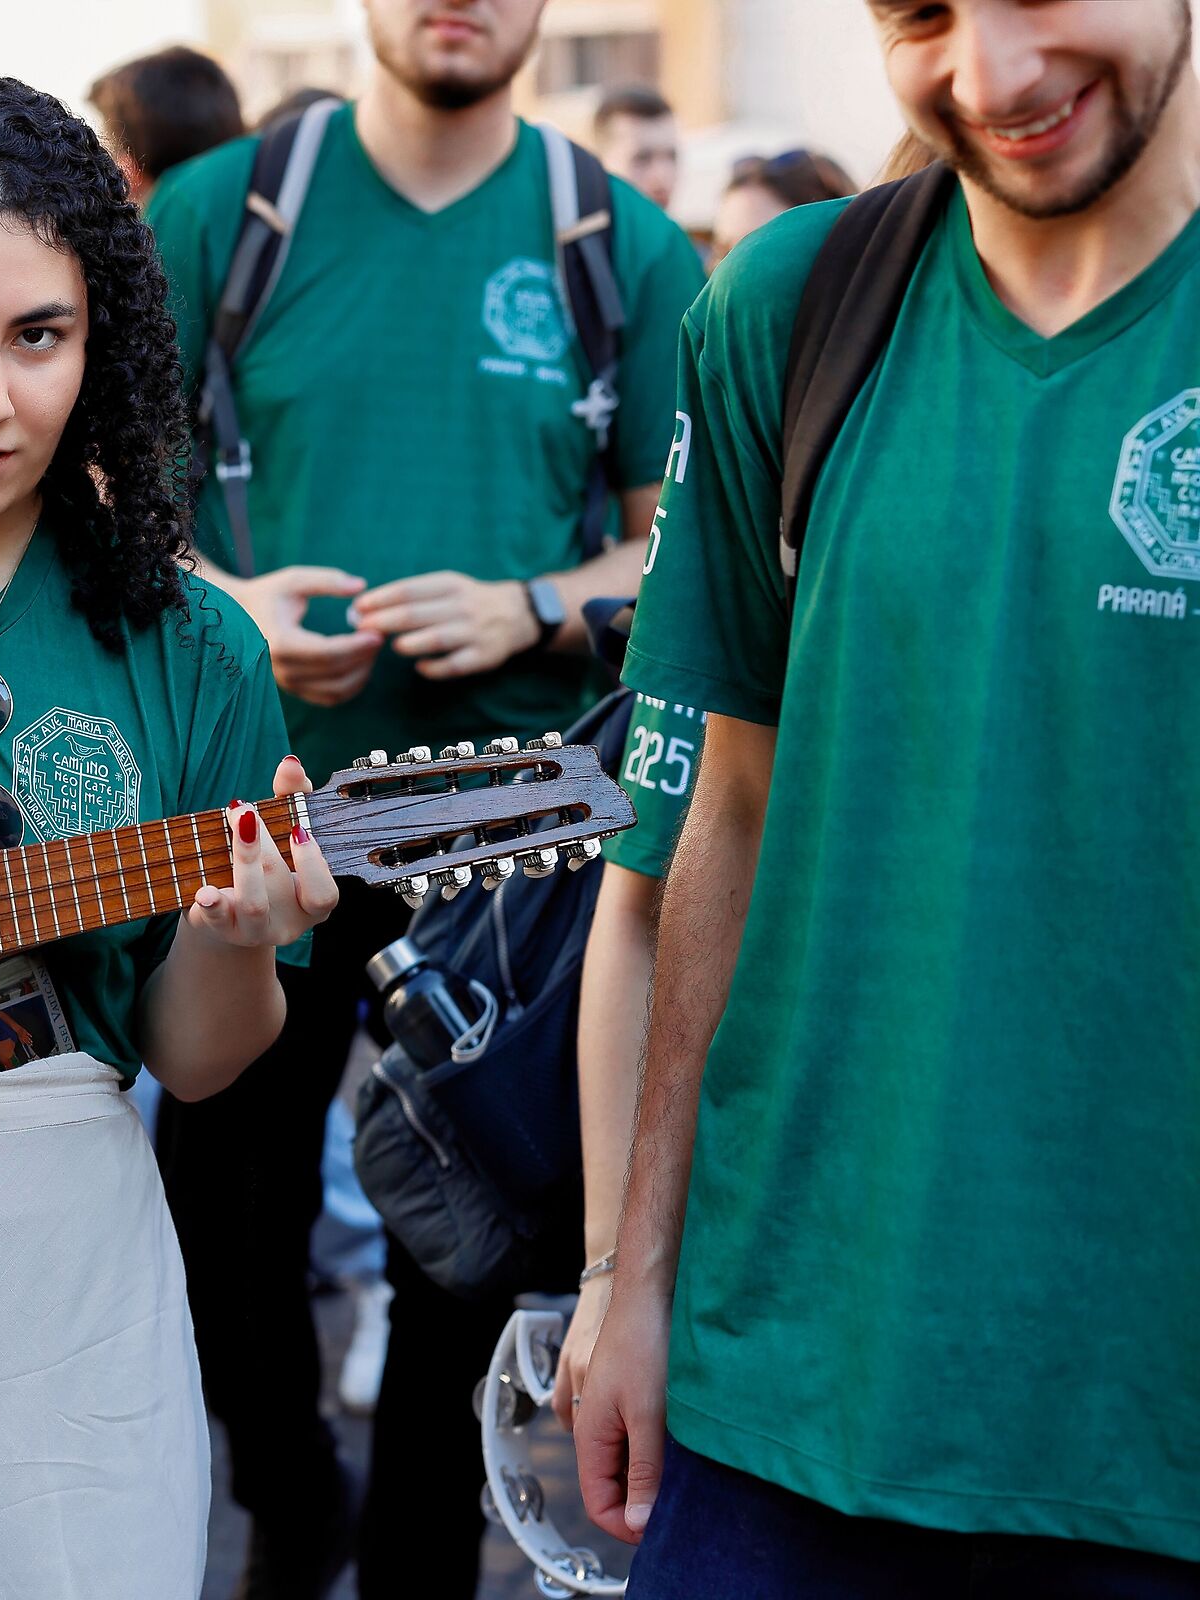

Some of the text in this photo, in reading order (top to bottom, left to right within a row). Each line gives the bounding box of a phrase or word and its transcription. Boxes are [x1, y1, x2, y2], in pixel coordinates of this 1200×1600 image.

[1097, 583, 1187, 620] PARANÁ
[41, 715, 102, 737] AVE MARIA
[18, 788, 48, 830] LITURGIA
